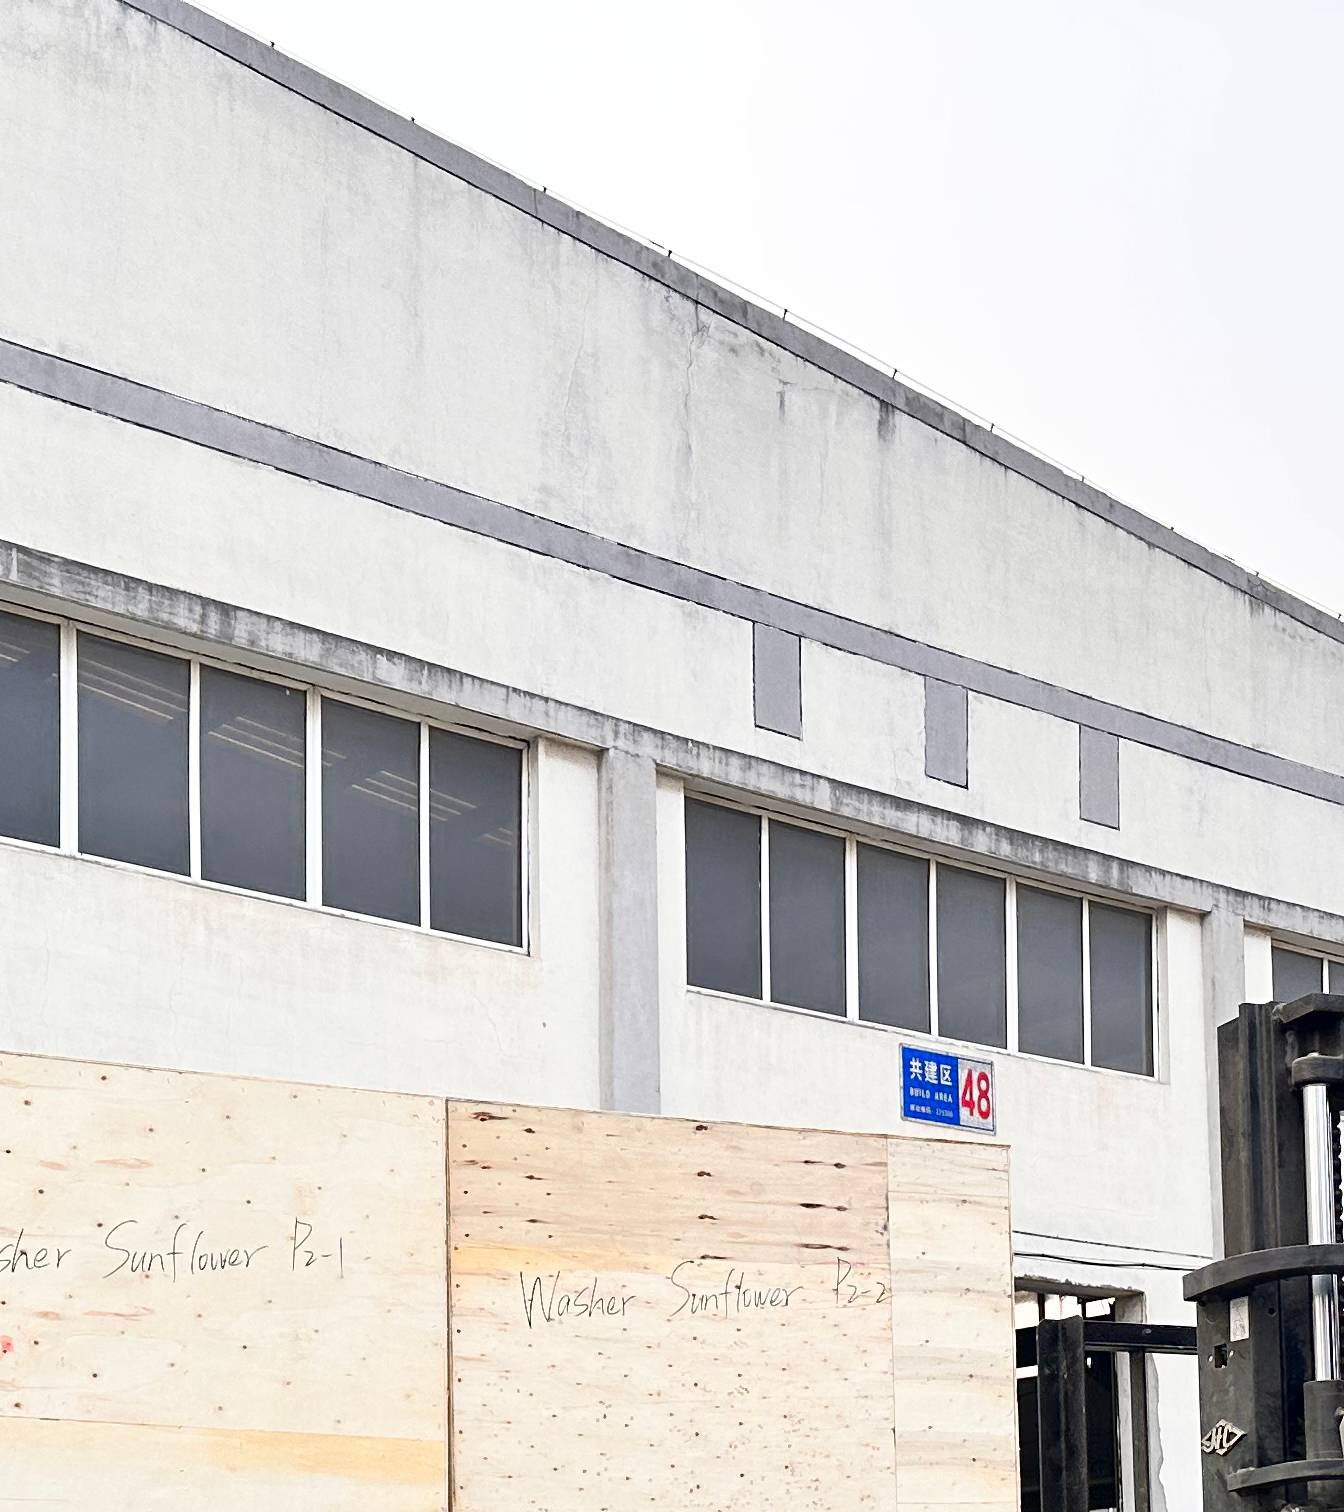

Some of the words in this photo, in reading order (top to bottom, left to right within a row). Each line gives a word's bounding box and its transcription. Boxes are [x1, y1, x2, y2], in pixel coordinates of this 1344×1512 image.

[910, 1058, 952, 1085] 共建区
[961, 1068, 991, 1120] 48
[103, 1219, 270, 1283] Sunflower
[519, 1270, 637, 1329] Washer
[669, 1260, 804, 1320] Sunflower
